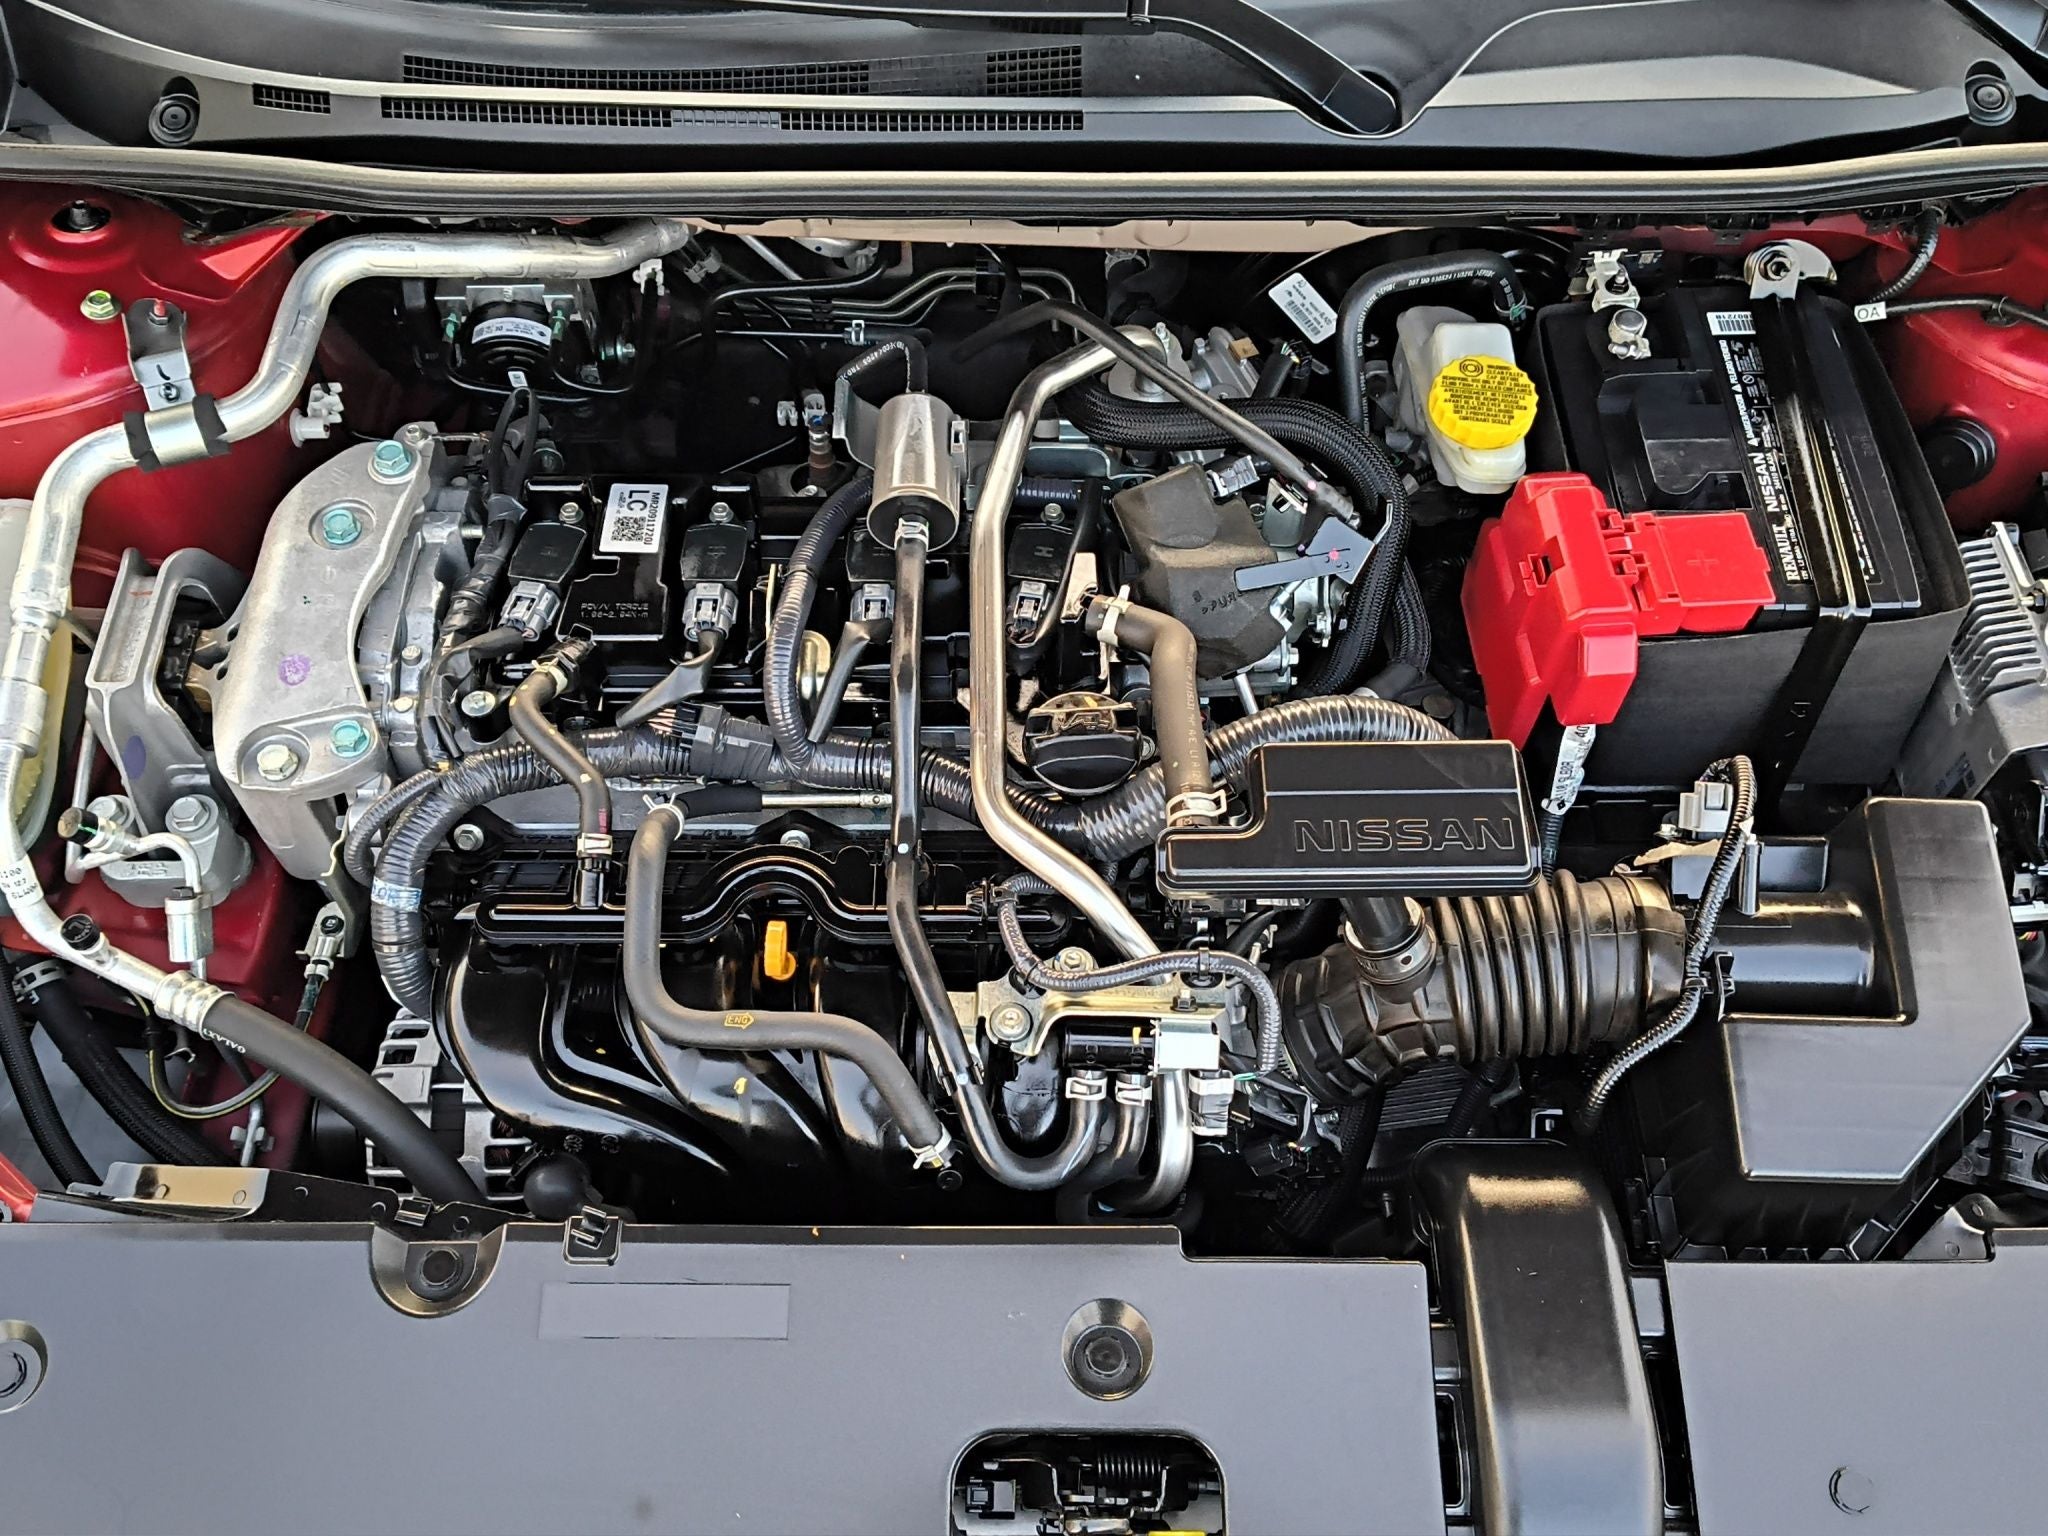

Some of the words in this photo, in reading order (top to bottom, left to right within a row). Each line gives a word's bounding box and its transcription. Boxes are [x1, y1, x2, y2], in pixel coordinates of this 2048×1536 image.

[626, 490, 650, 511] LC
[1748, 452, 1781, 513] NISSAN
[1772, 523, 1801, 581] RENAULT
[1294, 818, 1515, 852] NISSAN
